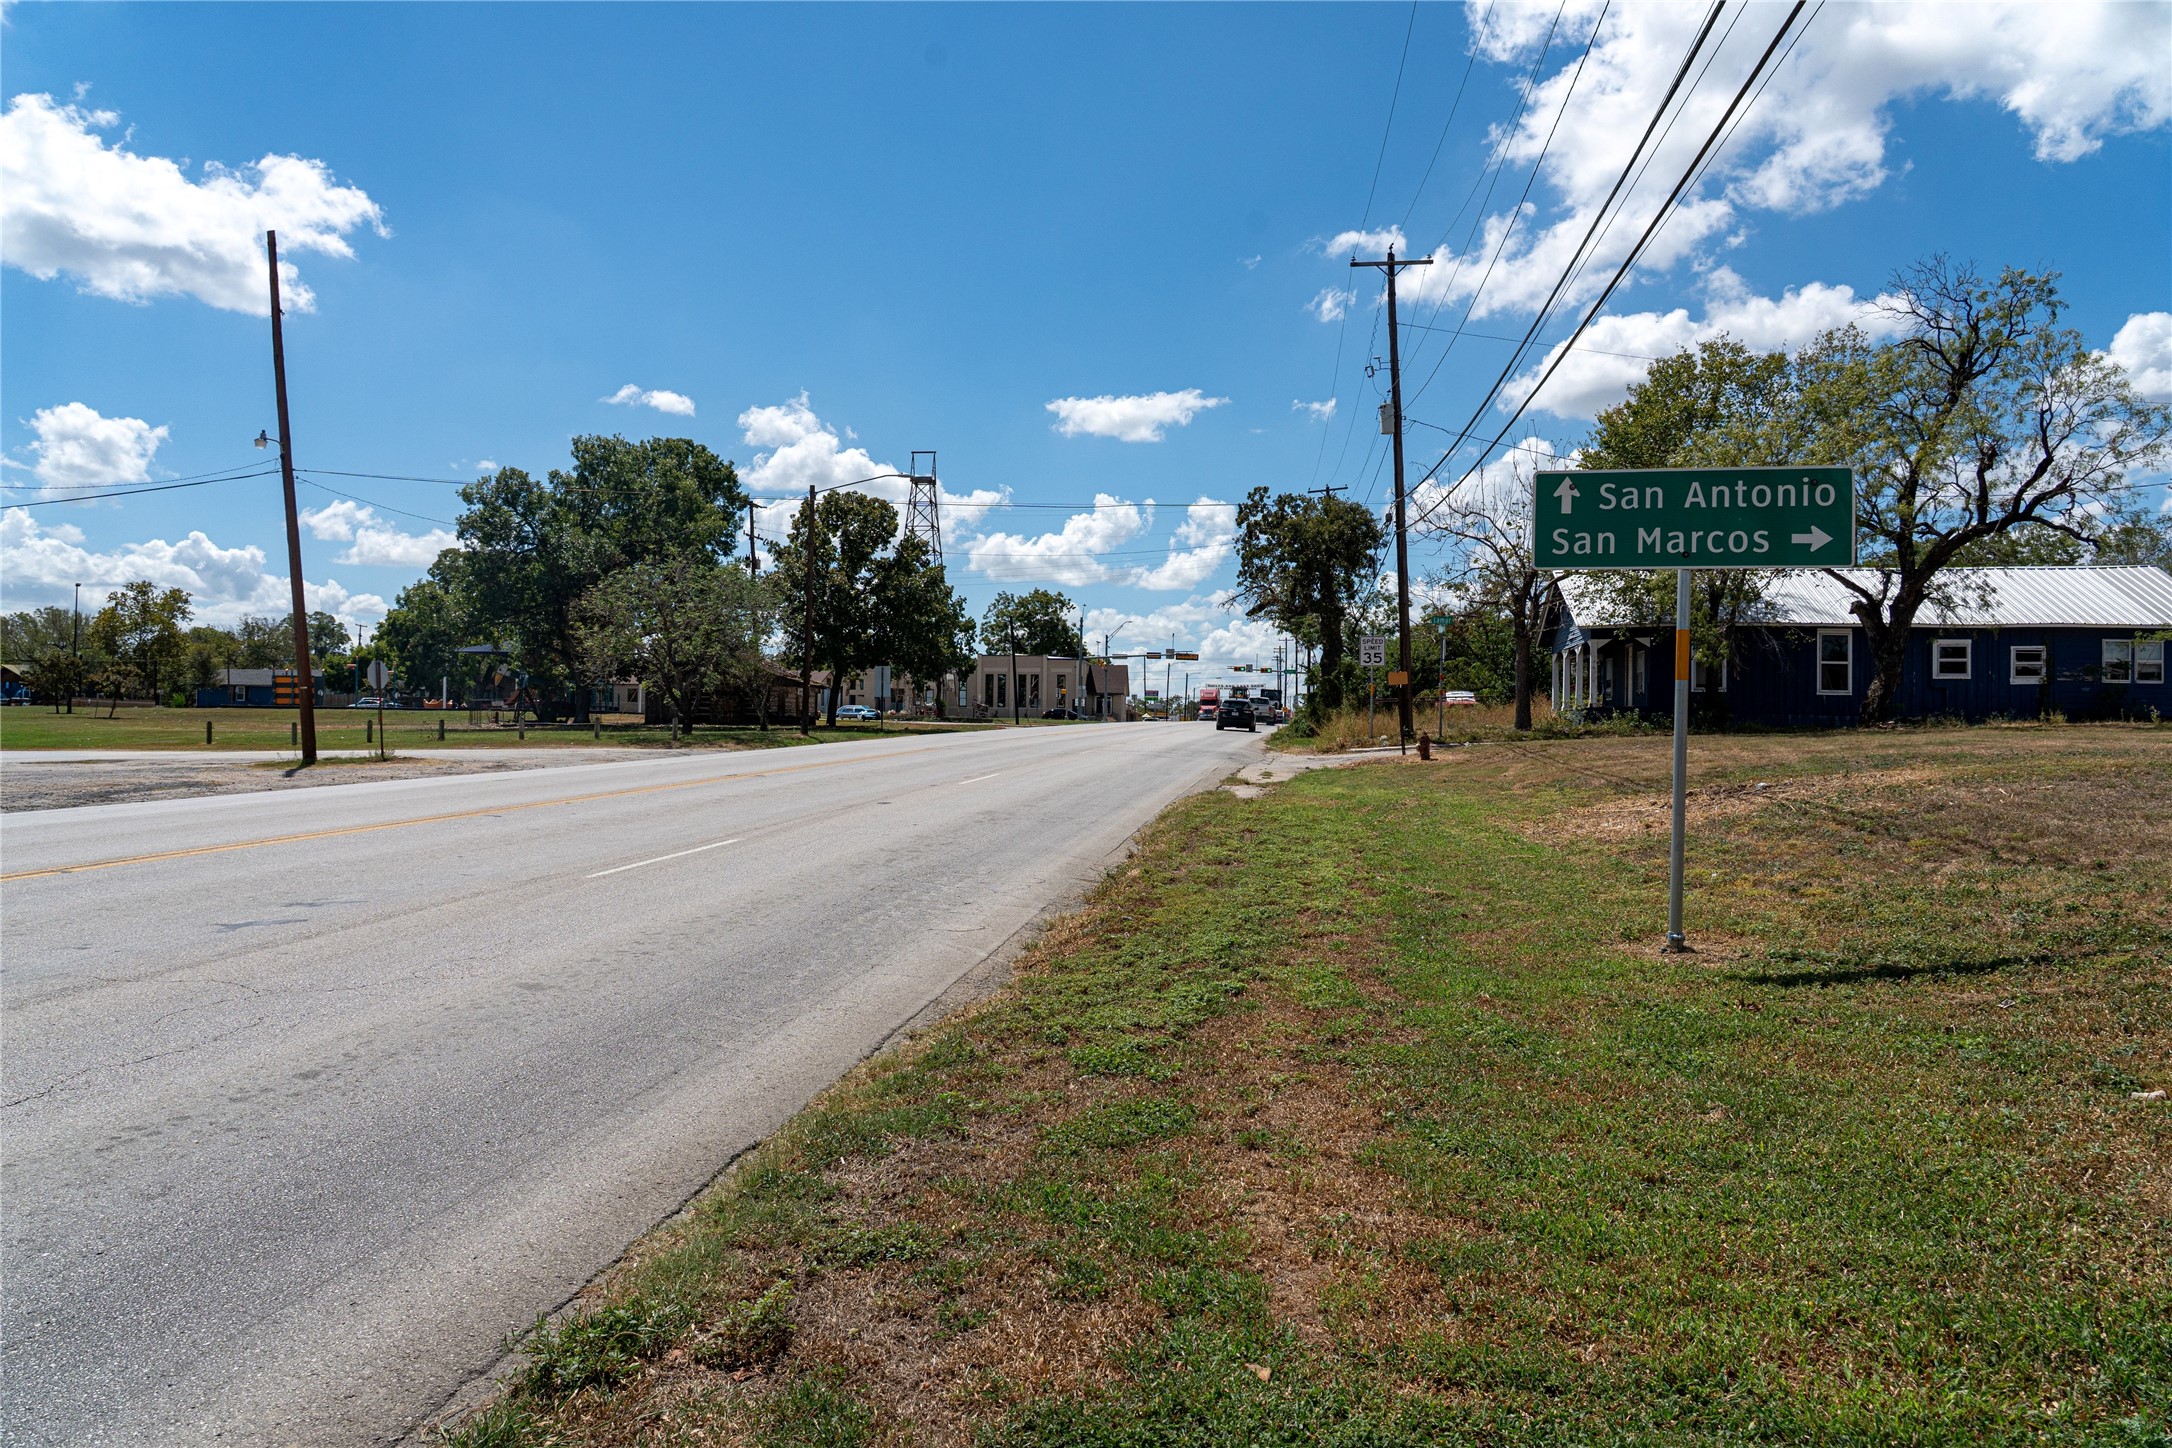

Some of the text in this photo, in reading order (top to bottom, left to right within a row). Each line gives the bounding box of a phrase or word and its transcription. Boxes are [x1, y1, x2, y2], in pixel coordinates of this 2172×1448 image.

[1599, 477, 1836, 510] San Antonio
[1552, 527, 1769, 555] San Marcos
[1363, 652, 1382, 663] 35
